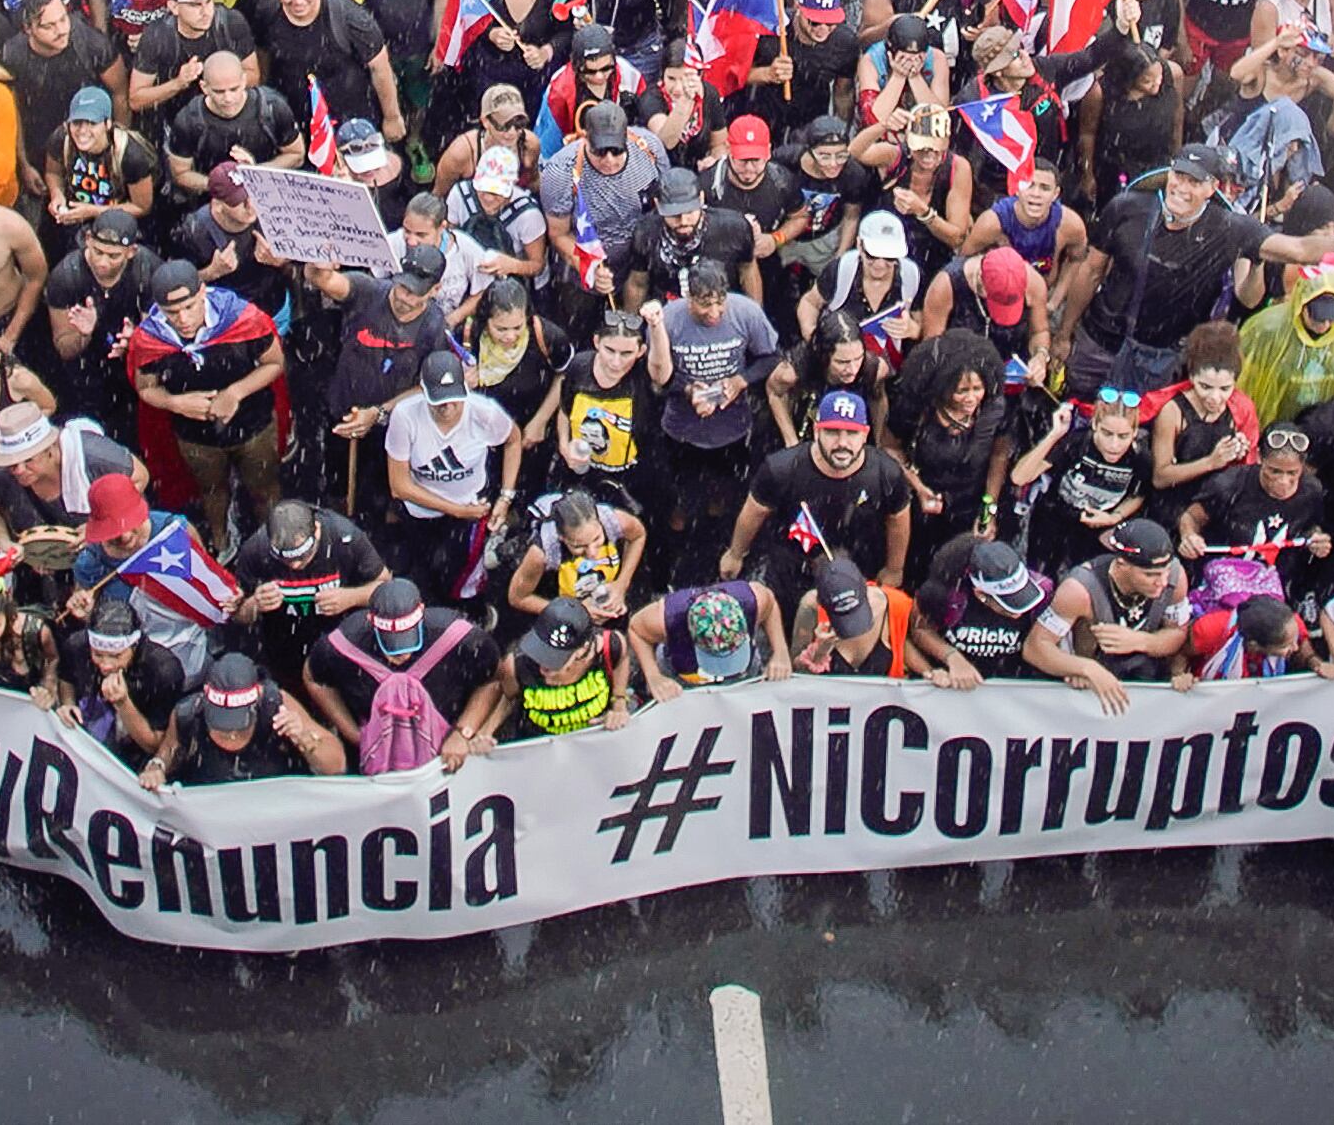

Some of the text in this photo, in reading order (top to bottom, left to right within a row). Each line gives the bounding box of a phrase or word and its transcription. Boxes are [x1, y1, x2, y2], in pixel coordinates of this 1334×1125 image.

[833, 396, 855, 419] PR
[414, 468, 474, 483] adidas
[956, 626, 1022, 651] #Ricky
[523, 685, 575, 712] SOMOS
